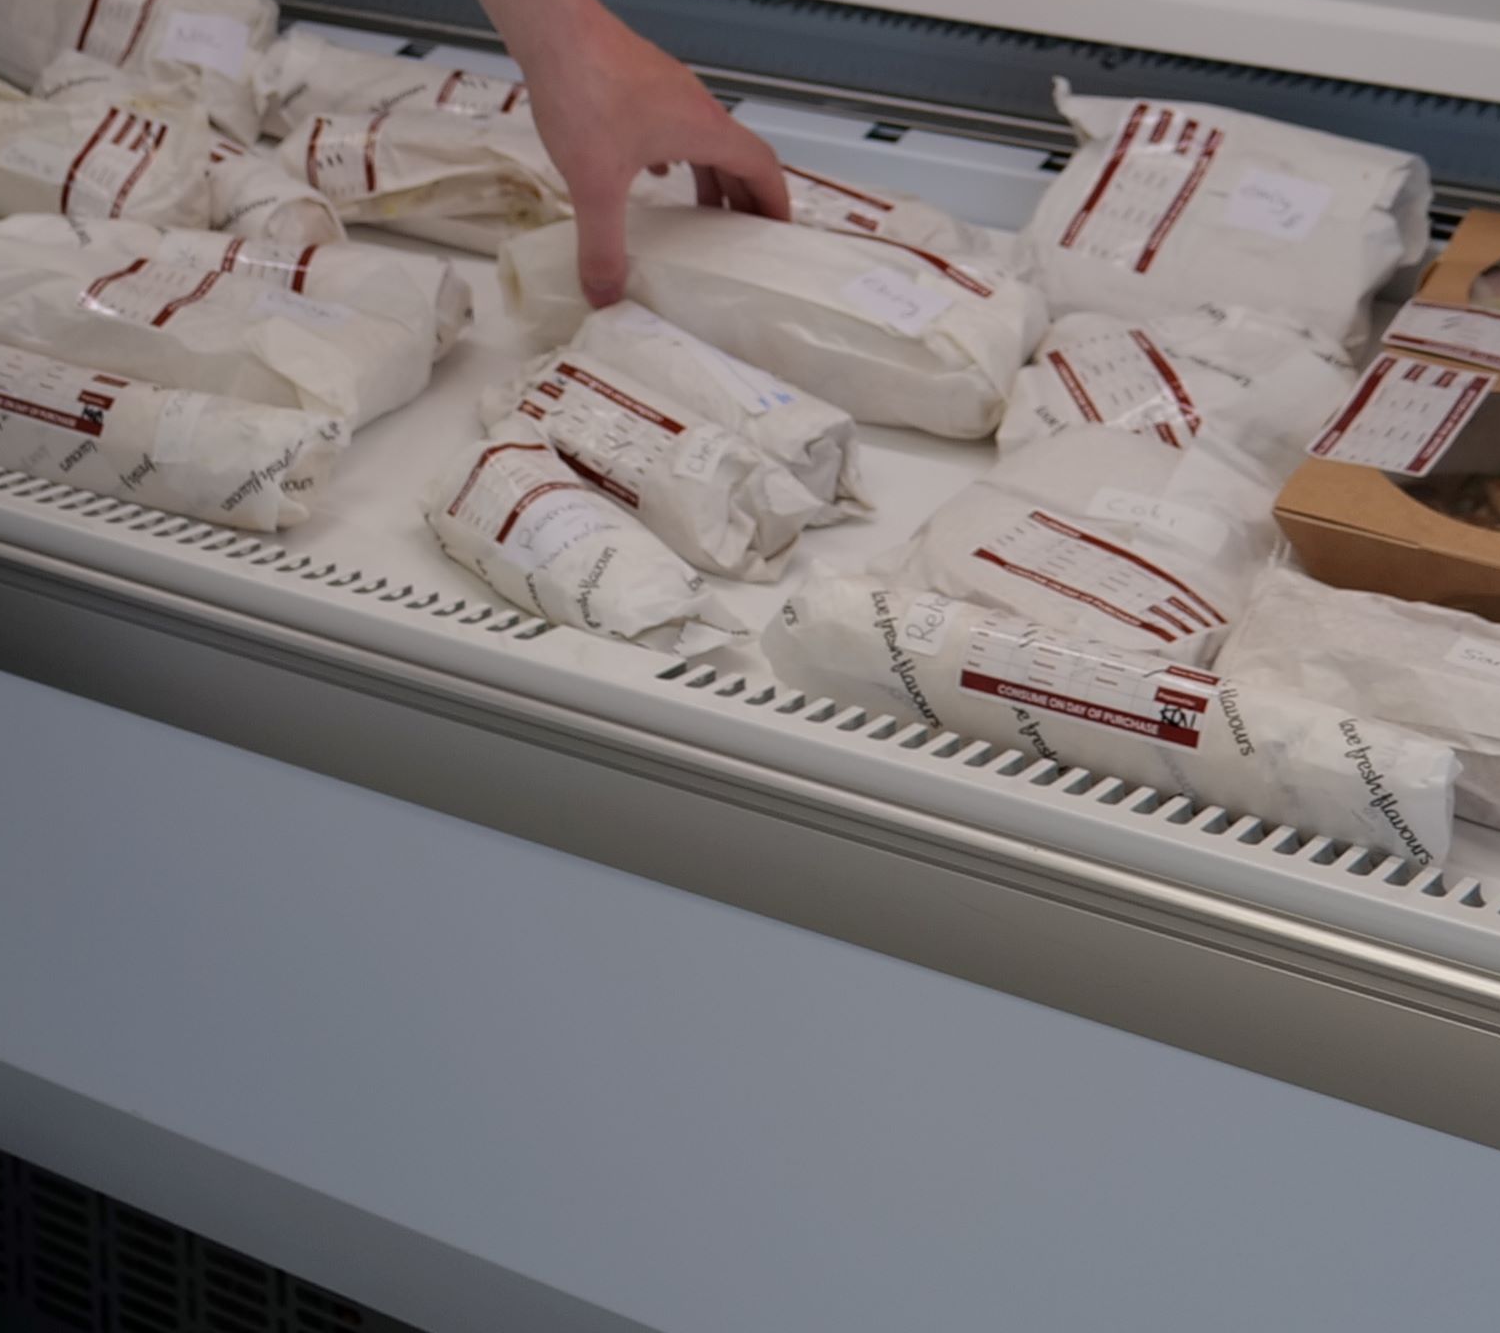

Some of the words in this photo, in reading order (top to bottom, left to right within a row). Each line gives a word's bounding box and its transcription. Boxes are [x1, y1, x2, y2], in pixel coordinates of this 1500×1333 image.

[889, 657, 944, 731] flavours
[996, 684, 1048, 708] CONSUME
[1048, 696, 1066, 712] ON
[1066, 701, 1087, 717] DAY
[1087, 707, 1103, 720] OF
[1103, 711, 1160, 735] PURCHASE
[1337, 717, 1362, 746] love
[1344, 745, 1386, 796] fresh
[1369, 791, 1435, 867] flavours
